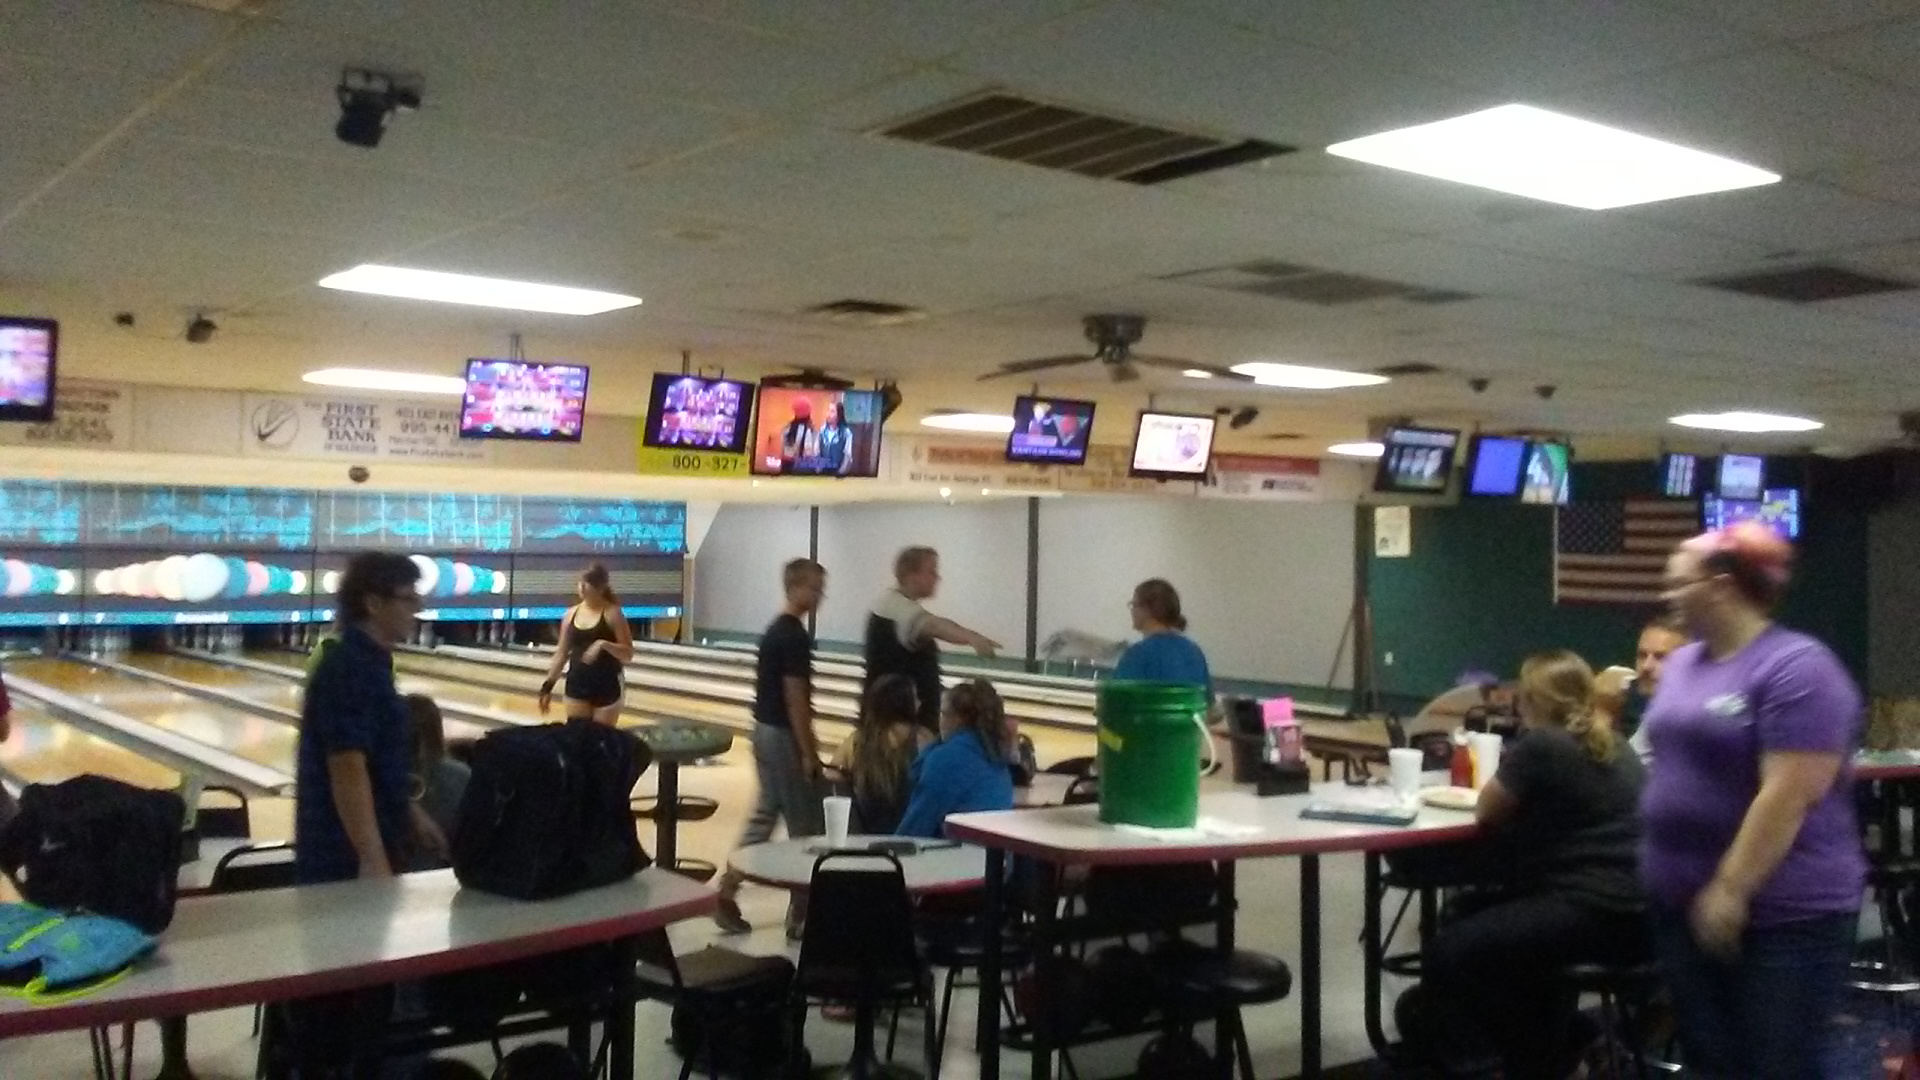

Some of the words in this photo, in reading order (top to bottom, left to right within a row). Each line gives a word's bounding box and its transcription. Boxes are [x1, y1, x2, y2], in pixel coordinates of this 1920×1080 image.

[326, 402, 378, 416] FIRST
[322, 414, 381, 430] STATE
[328, 428, 376, 442] BANK
